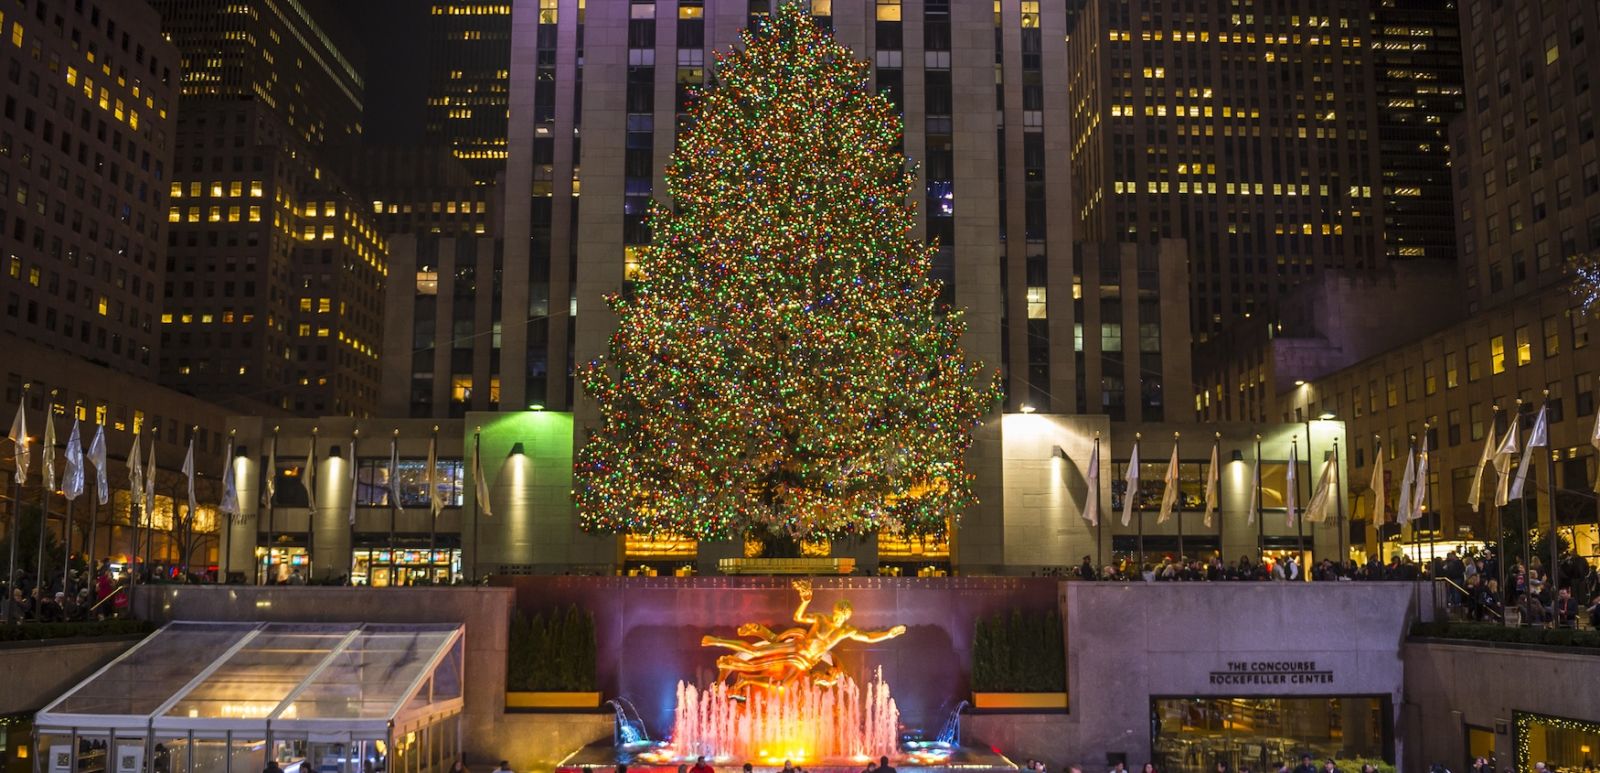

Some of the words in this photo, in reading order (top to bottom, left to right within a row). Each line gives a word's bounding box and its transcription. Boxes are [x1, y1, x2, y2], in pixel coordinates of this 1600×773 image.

[1227, 662, 1247, 671] THE
[1250, 661, 1316, 671] CONCOURSE
[1209, 675, 1286, 684] ROCKEFELLER
[1291, 674, 1333, 684] CENTER
